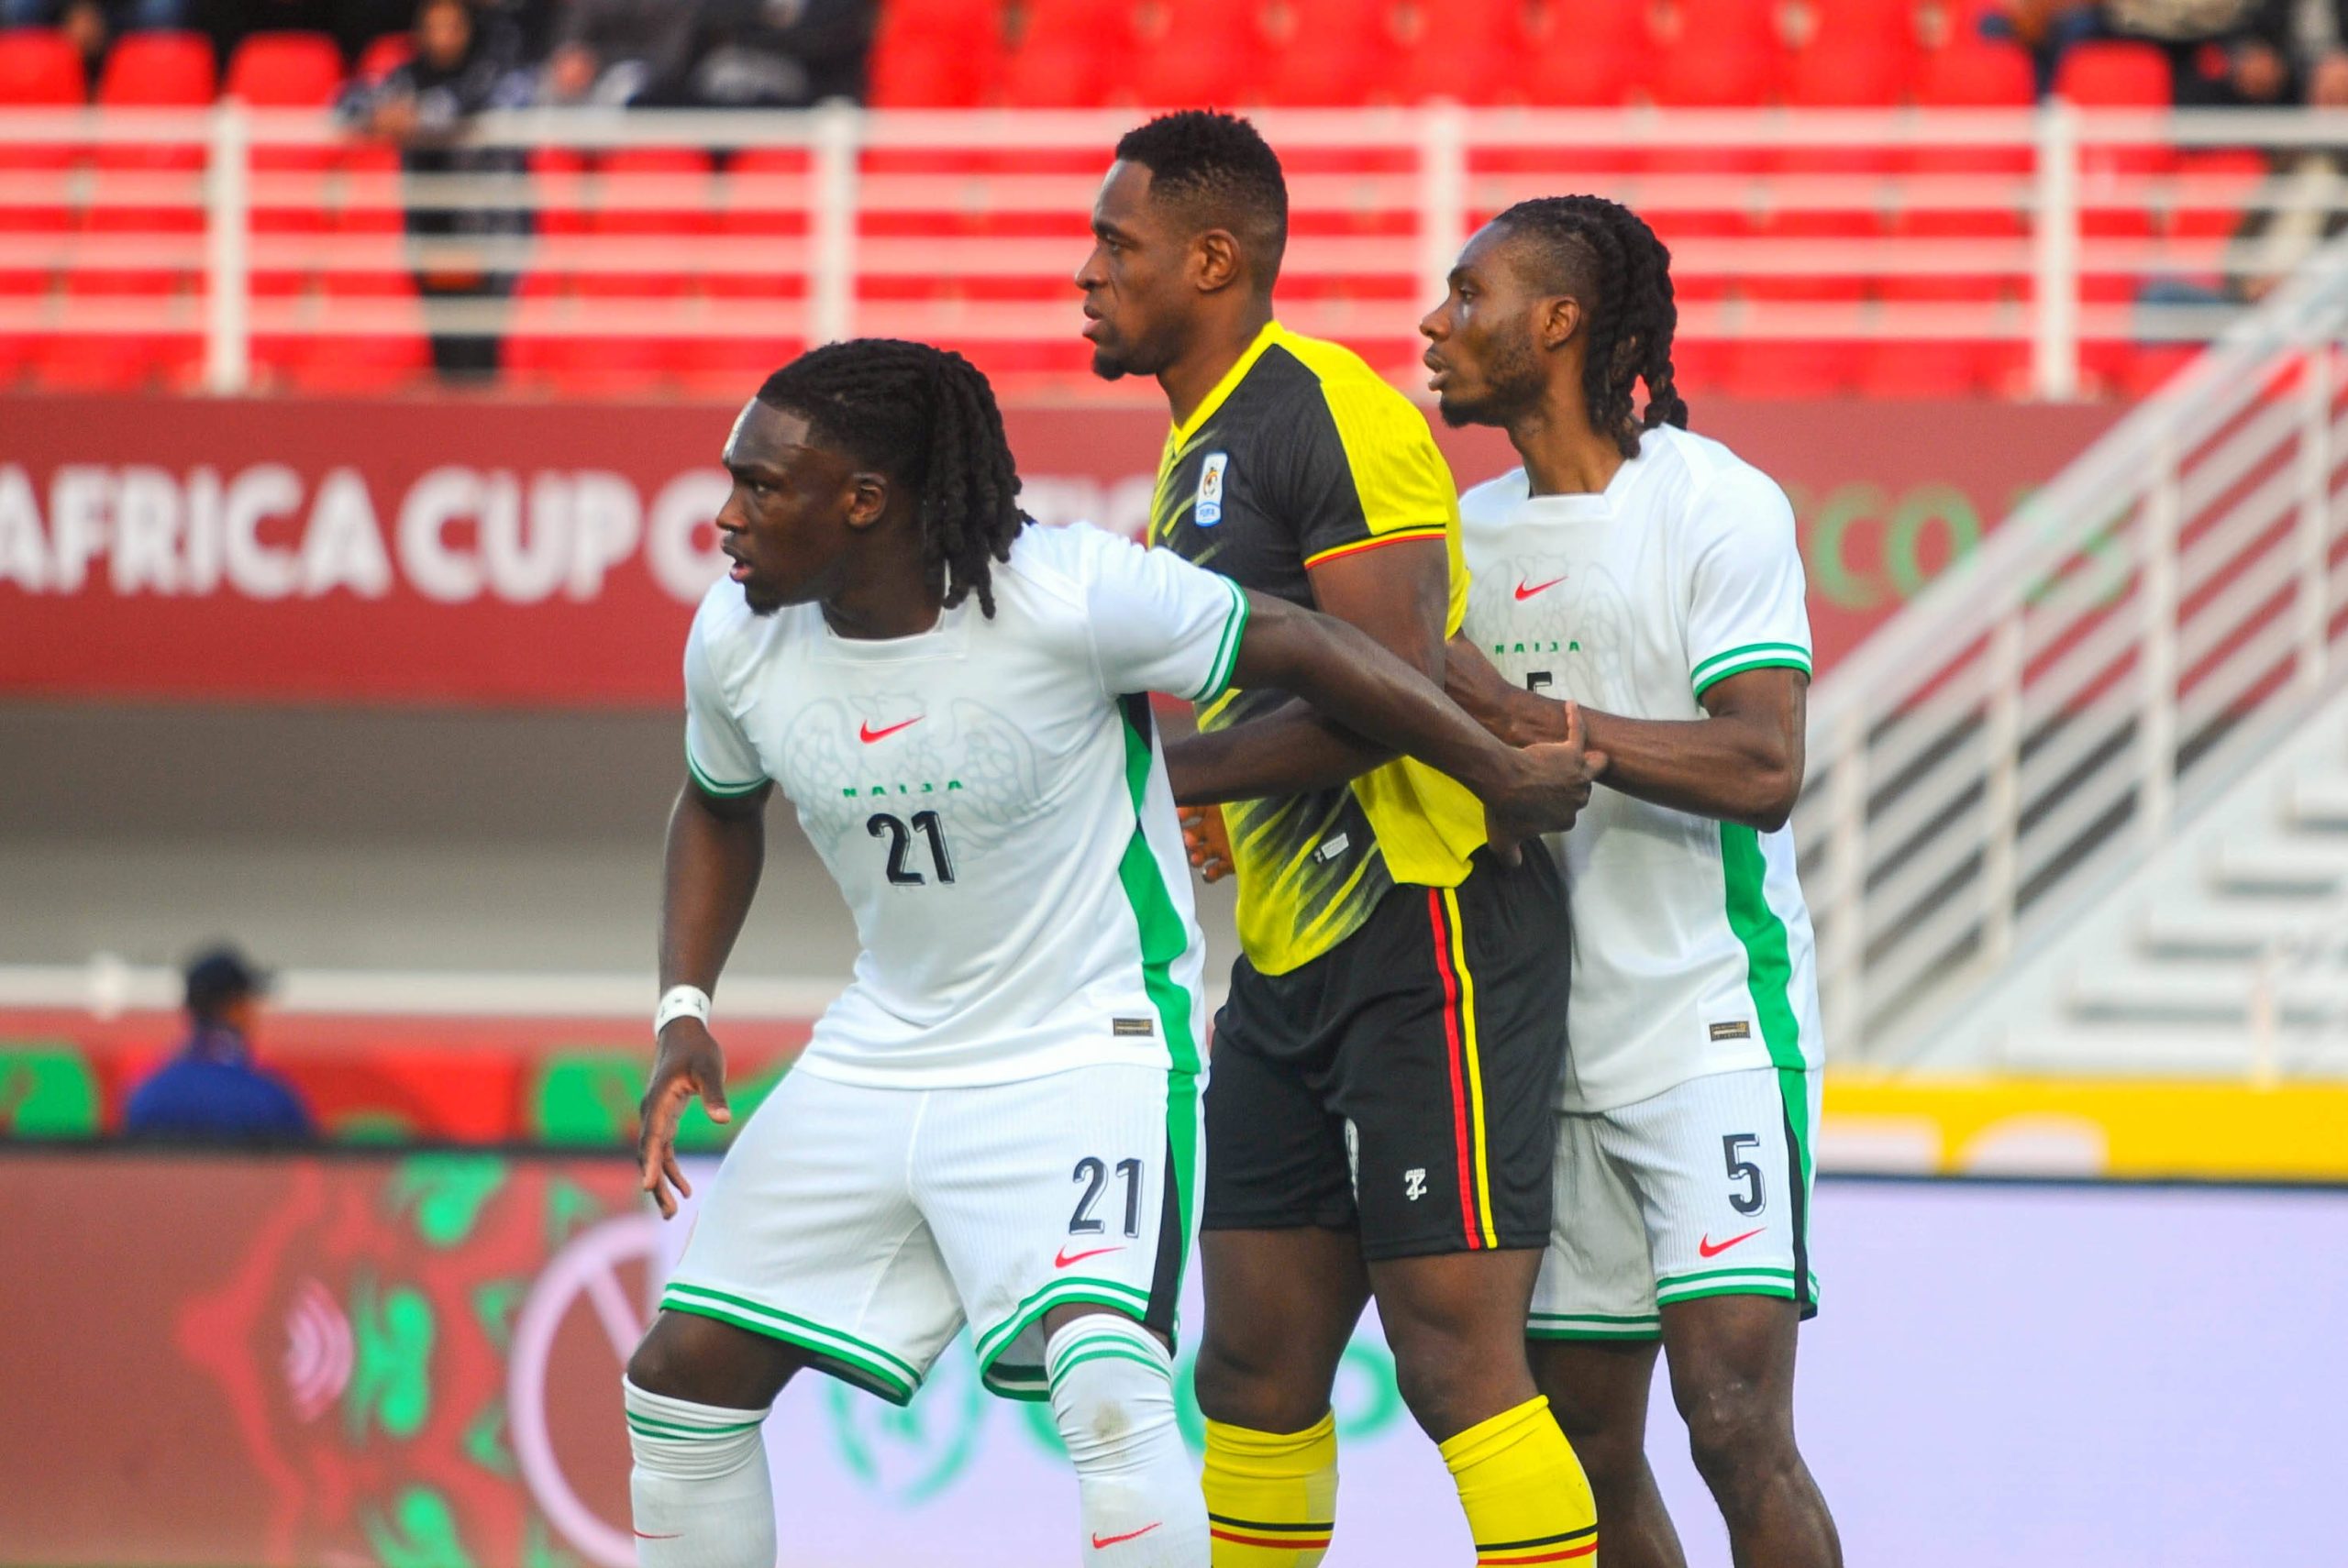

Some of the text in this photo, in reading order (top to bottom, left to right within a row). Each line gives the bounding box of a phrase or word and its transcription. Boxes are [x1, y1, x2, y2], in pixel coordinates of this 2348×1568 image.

[0, 463, 394, 600] AFRICA
[394, 465, 644, 605] CUP
[1495, 641, 1579, 654] NAIJA
[842, 779, 962, 797] NAIJA
[866, 811, 956, 886] 21
[1069, 1156, 1144, 1239] 21
[1722, 1133, 1767, 1218] 5
